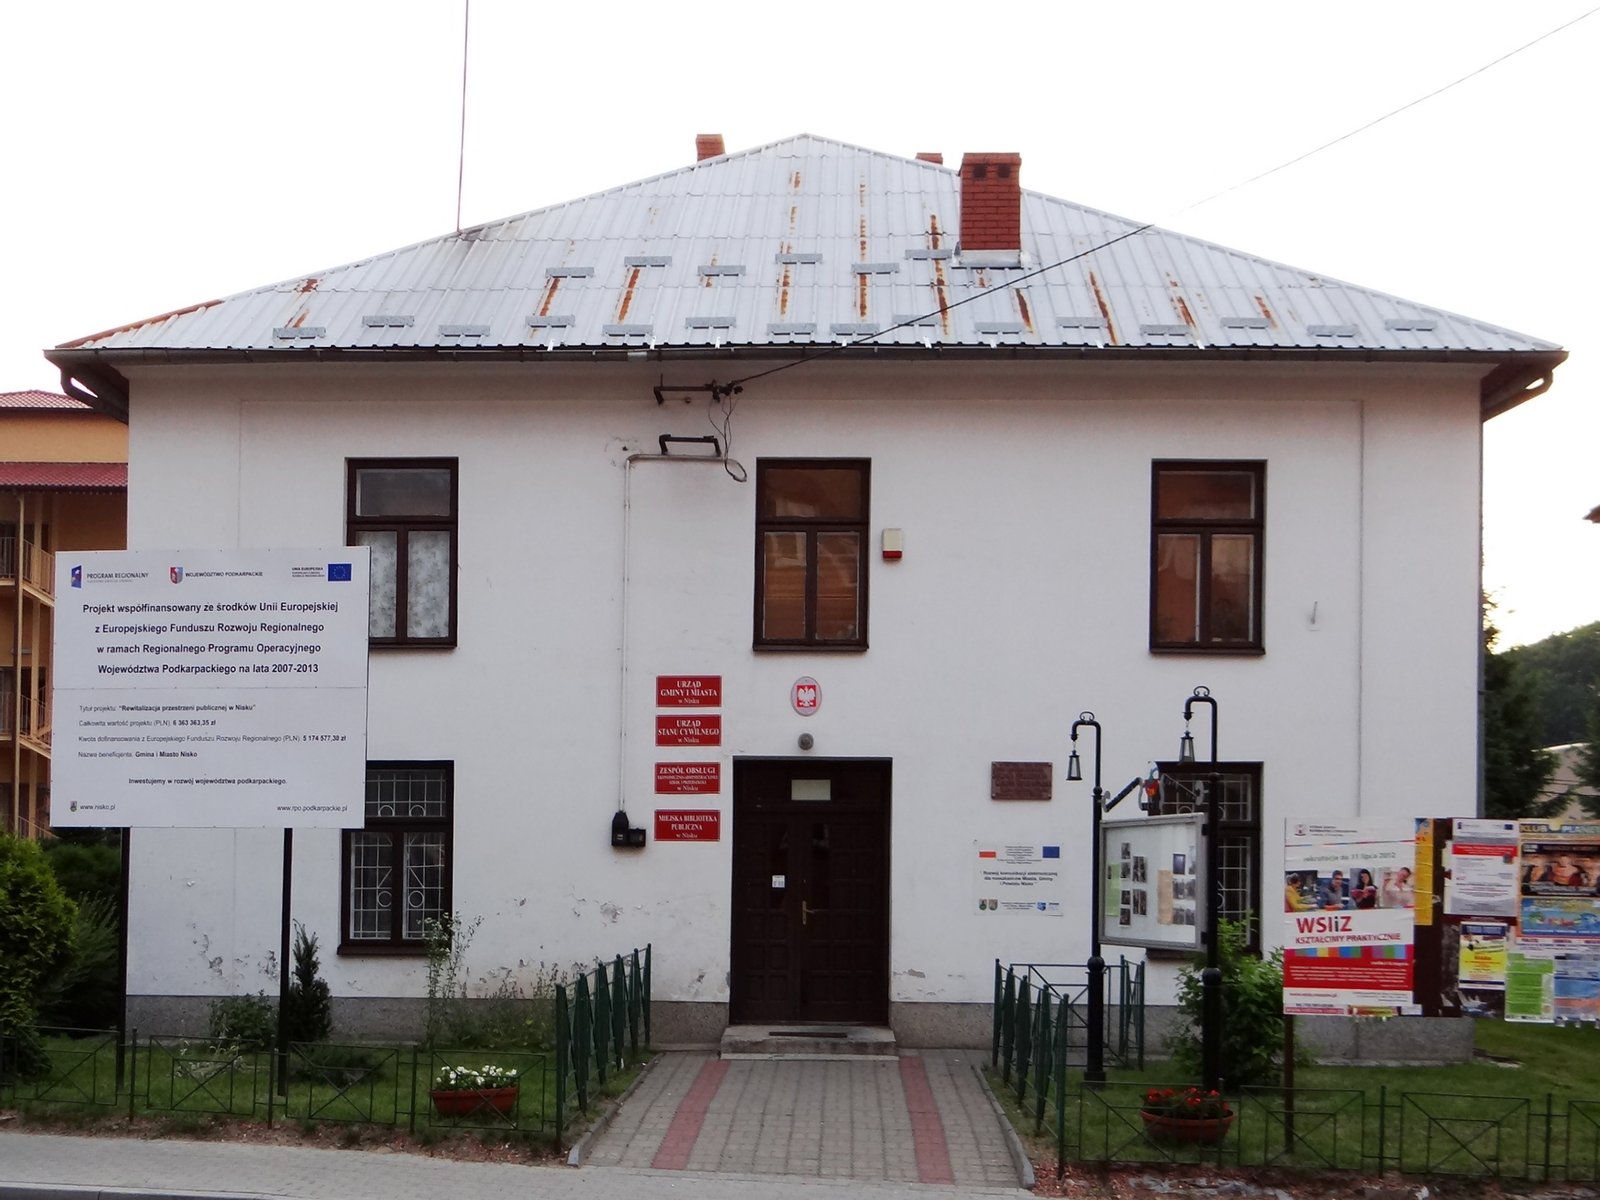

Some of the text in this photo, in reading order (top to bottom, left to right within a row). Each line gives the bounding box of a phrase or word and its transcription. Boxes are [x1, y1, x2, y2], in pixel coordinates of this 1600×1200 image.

[82, 604, 115, 616] Projekt
[117, 603, 202, 614] współfinansowany
[216, 602, 257, 612] środków
[259, 602, 278, 612] Unii
[280, 601, 338, 613] Europejskiej
[102, 623, 168, 635] Europejskiego
[170, 623, 215, 633] Funduszu
[217, 622, 258, 634] Rozwoju
[260, 622, 325, 634] Regionalnego
[106, 644, 140, 654] ramach
[142, 644, 206, 656] Regionalnego
[208, 643, 254, 655] Programu
[256, 643, 322, 655] Operacyjnego
[98, 664, 160, 676] Województwa
[162, 664, 237, 676] Podkarpackiego
[252, 664, 270, 673] lata
[271, 663, 319, 673] 2007-2013
[676, 680, 702, 689] URZĄD
[660, 688, 684, 697] GMINY
[690, 688, 718, 697] MIASTA
[676, 719, 701, 728] URZĄD
[679, 727, 720, 736] CYWILNEGO
[146, 735, 186, 744] Europejskiego
[216, 734, 241, 743] Rozwoju
[242, 734, 282, 743] Regionalnego
[320, 734, 340, 742] 577,30
[194, 778, 236, 786] województwa
[277, 805, 348, 813] www.rpo.podkarpackie.pl
[1296, 916, 1352, 934] WSIiZ
[1296, 933, 1401, 944] KSZTAŁCIMY PRAKTYCZNIE
